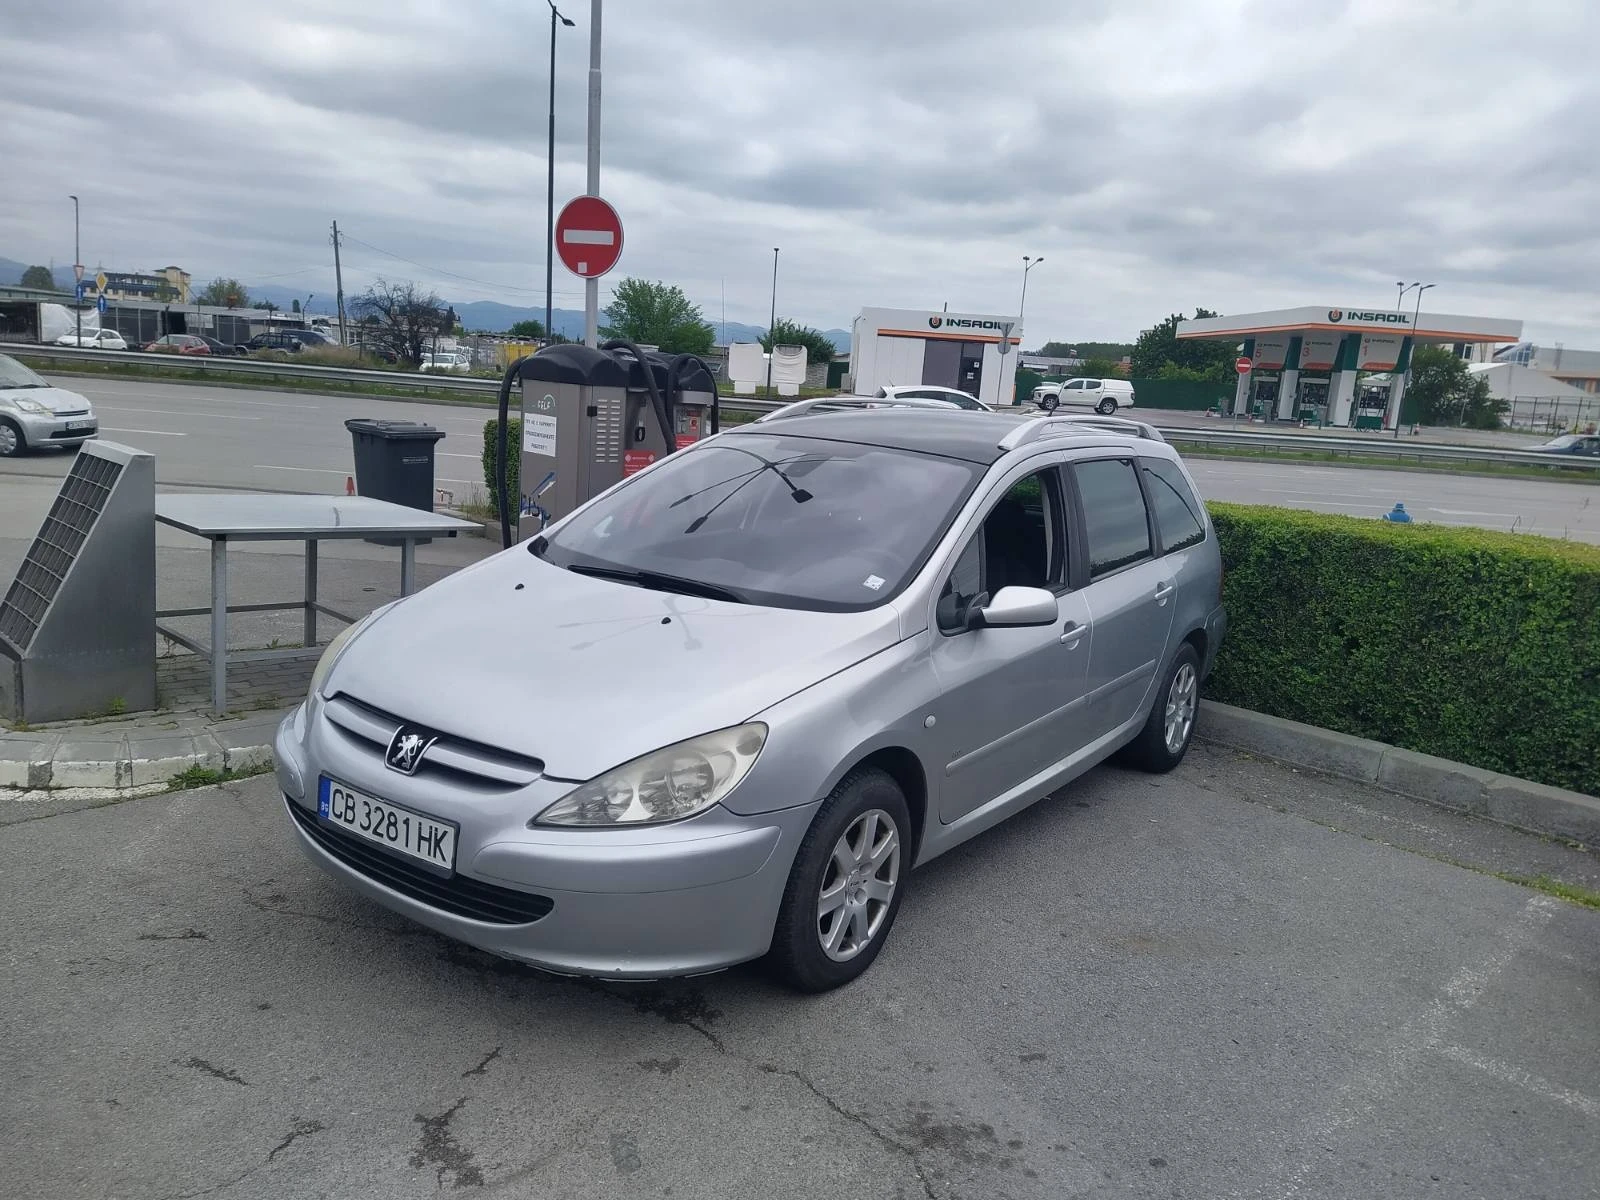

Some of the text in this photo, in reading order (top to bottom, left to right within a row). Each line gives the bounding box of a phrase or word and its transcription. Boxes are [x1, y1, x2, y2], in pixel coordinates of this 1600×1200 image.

[946, 318, 1002, 329] INSAOIL
[1347, 311, 1410, 324] INSAOIL
[1302, 346, 1311, 357] 3
[359, 800, 410, 848] 3281
[417, 821, 448, 862] HK
